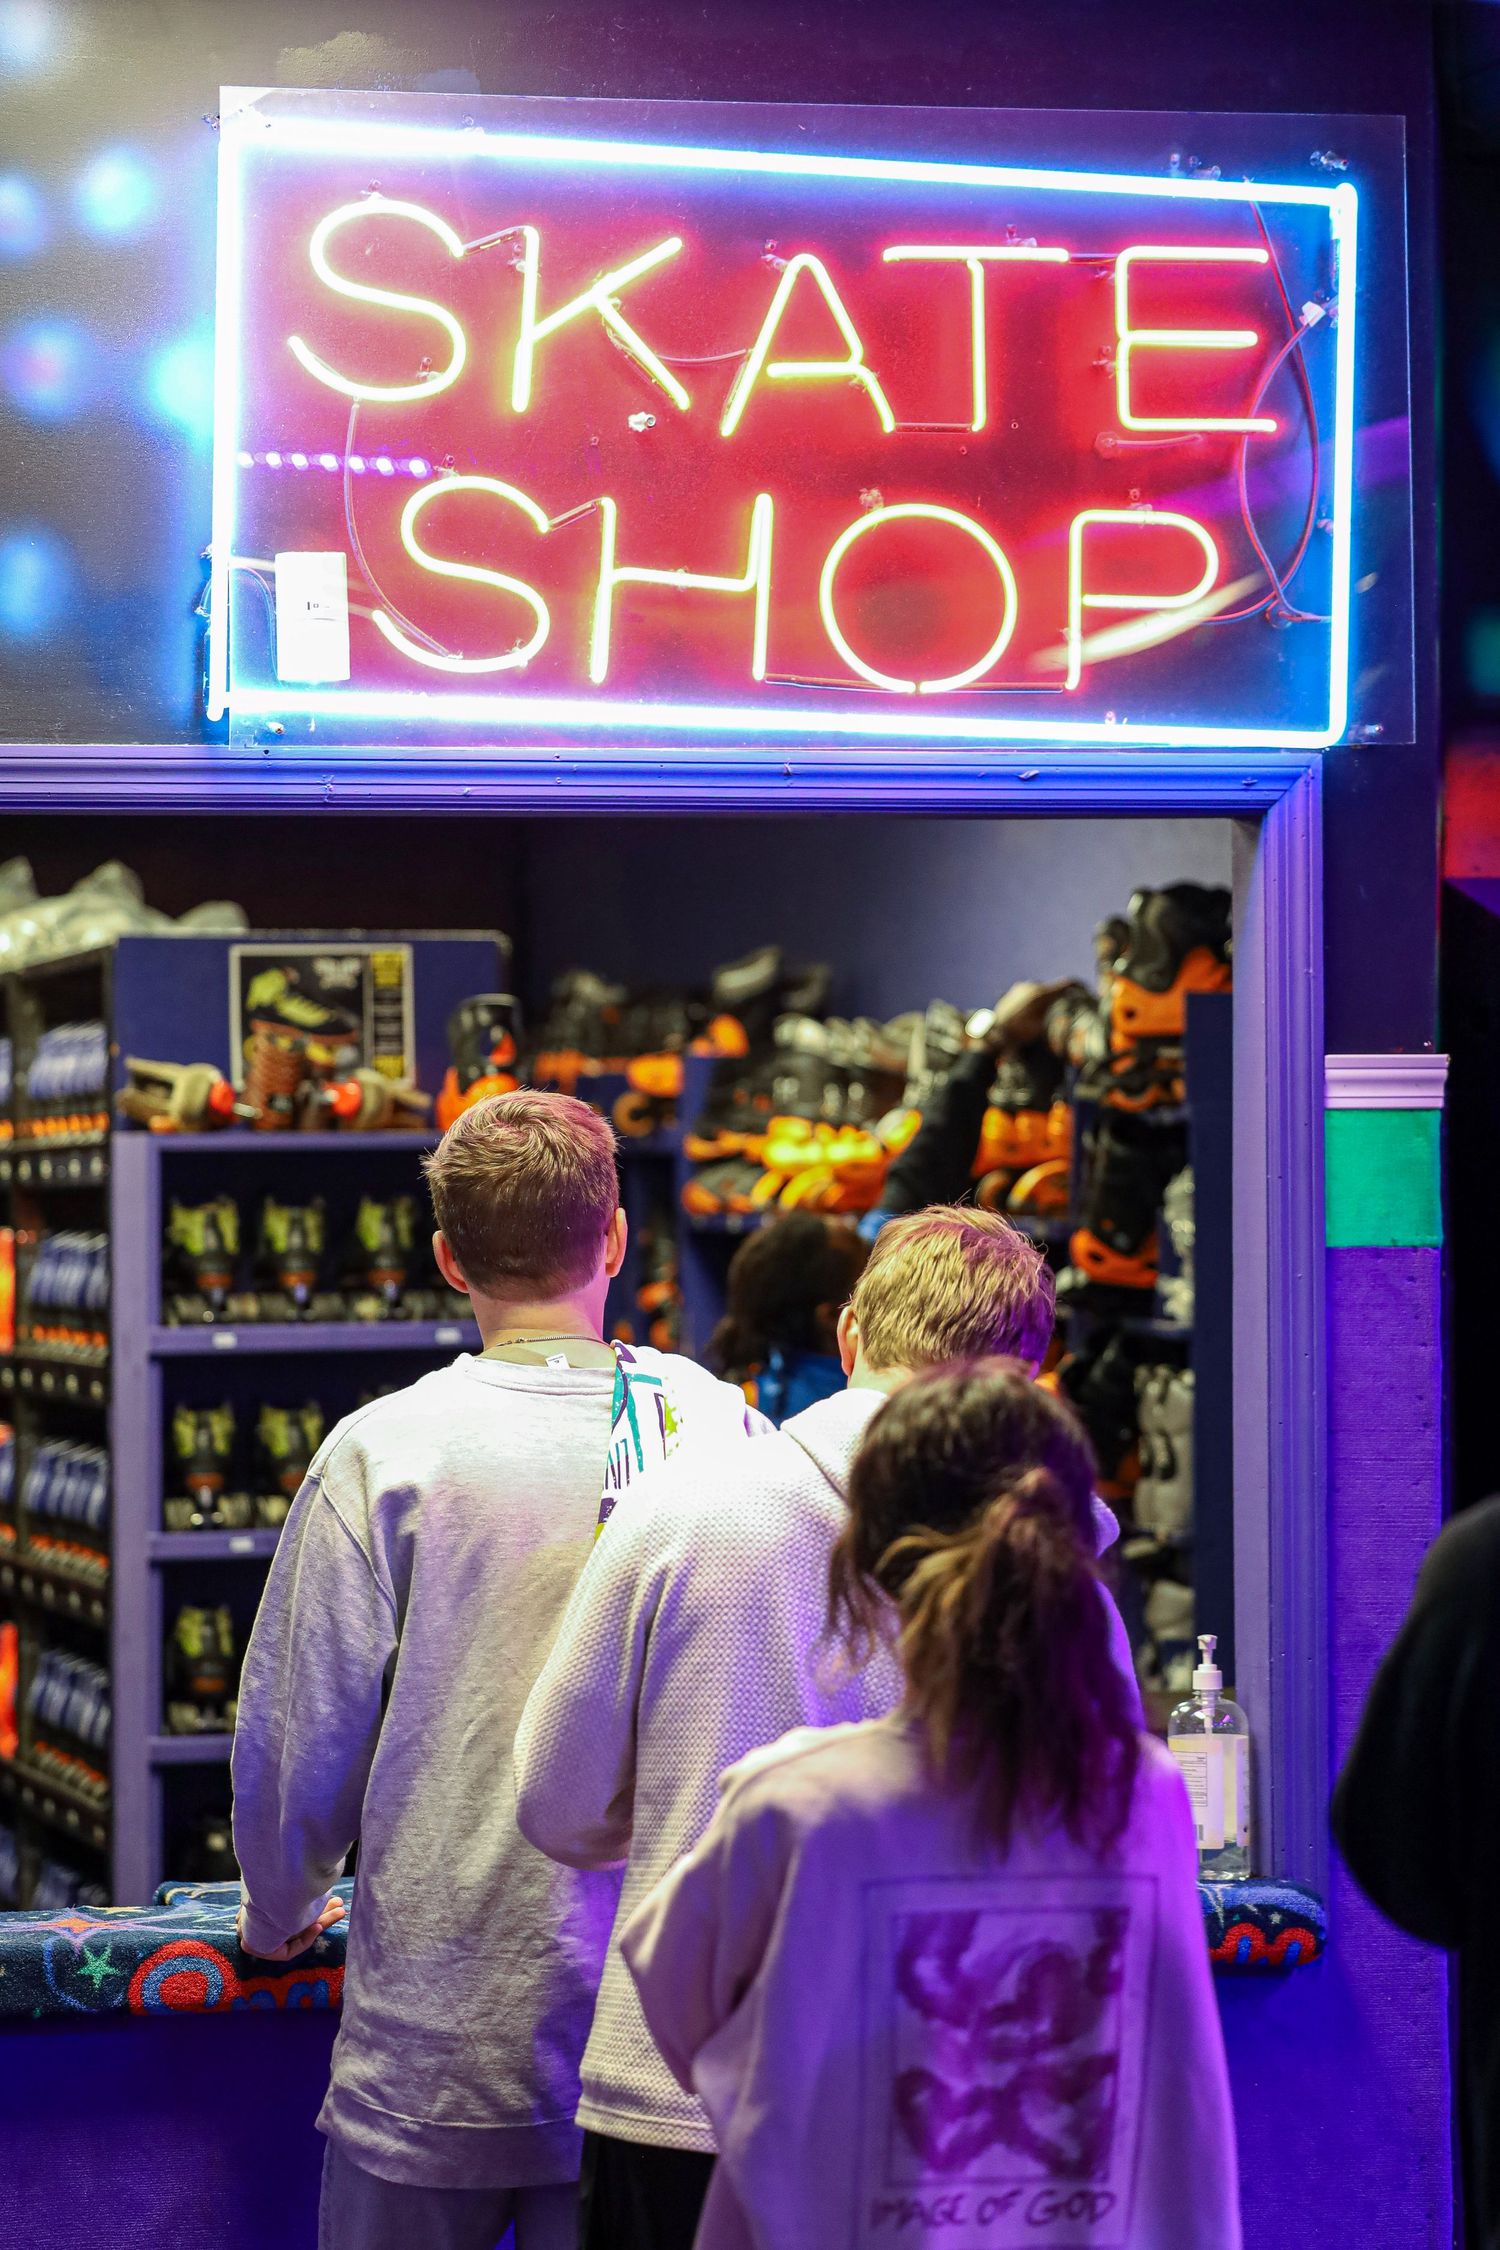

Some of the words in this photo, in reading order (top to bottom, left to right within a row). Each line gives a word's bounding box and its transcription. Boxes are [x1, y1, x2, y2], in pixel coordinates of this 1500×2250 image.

[286, 192, 1282, 437] SKATE
[366, 473, 1222, 695] SHOP
[977, 2188, 1022, 2227] OF
[1025, 2189, 1117, 2228] GOD
